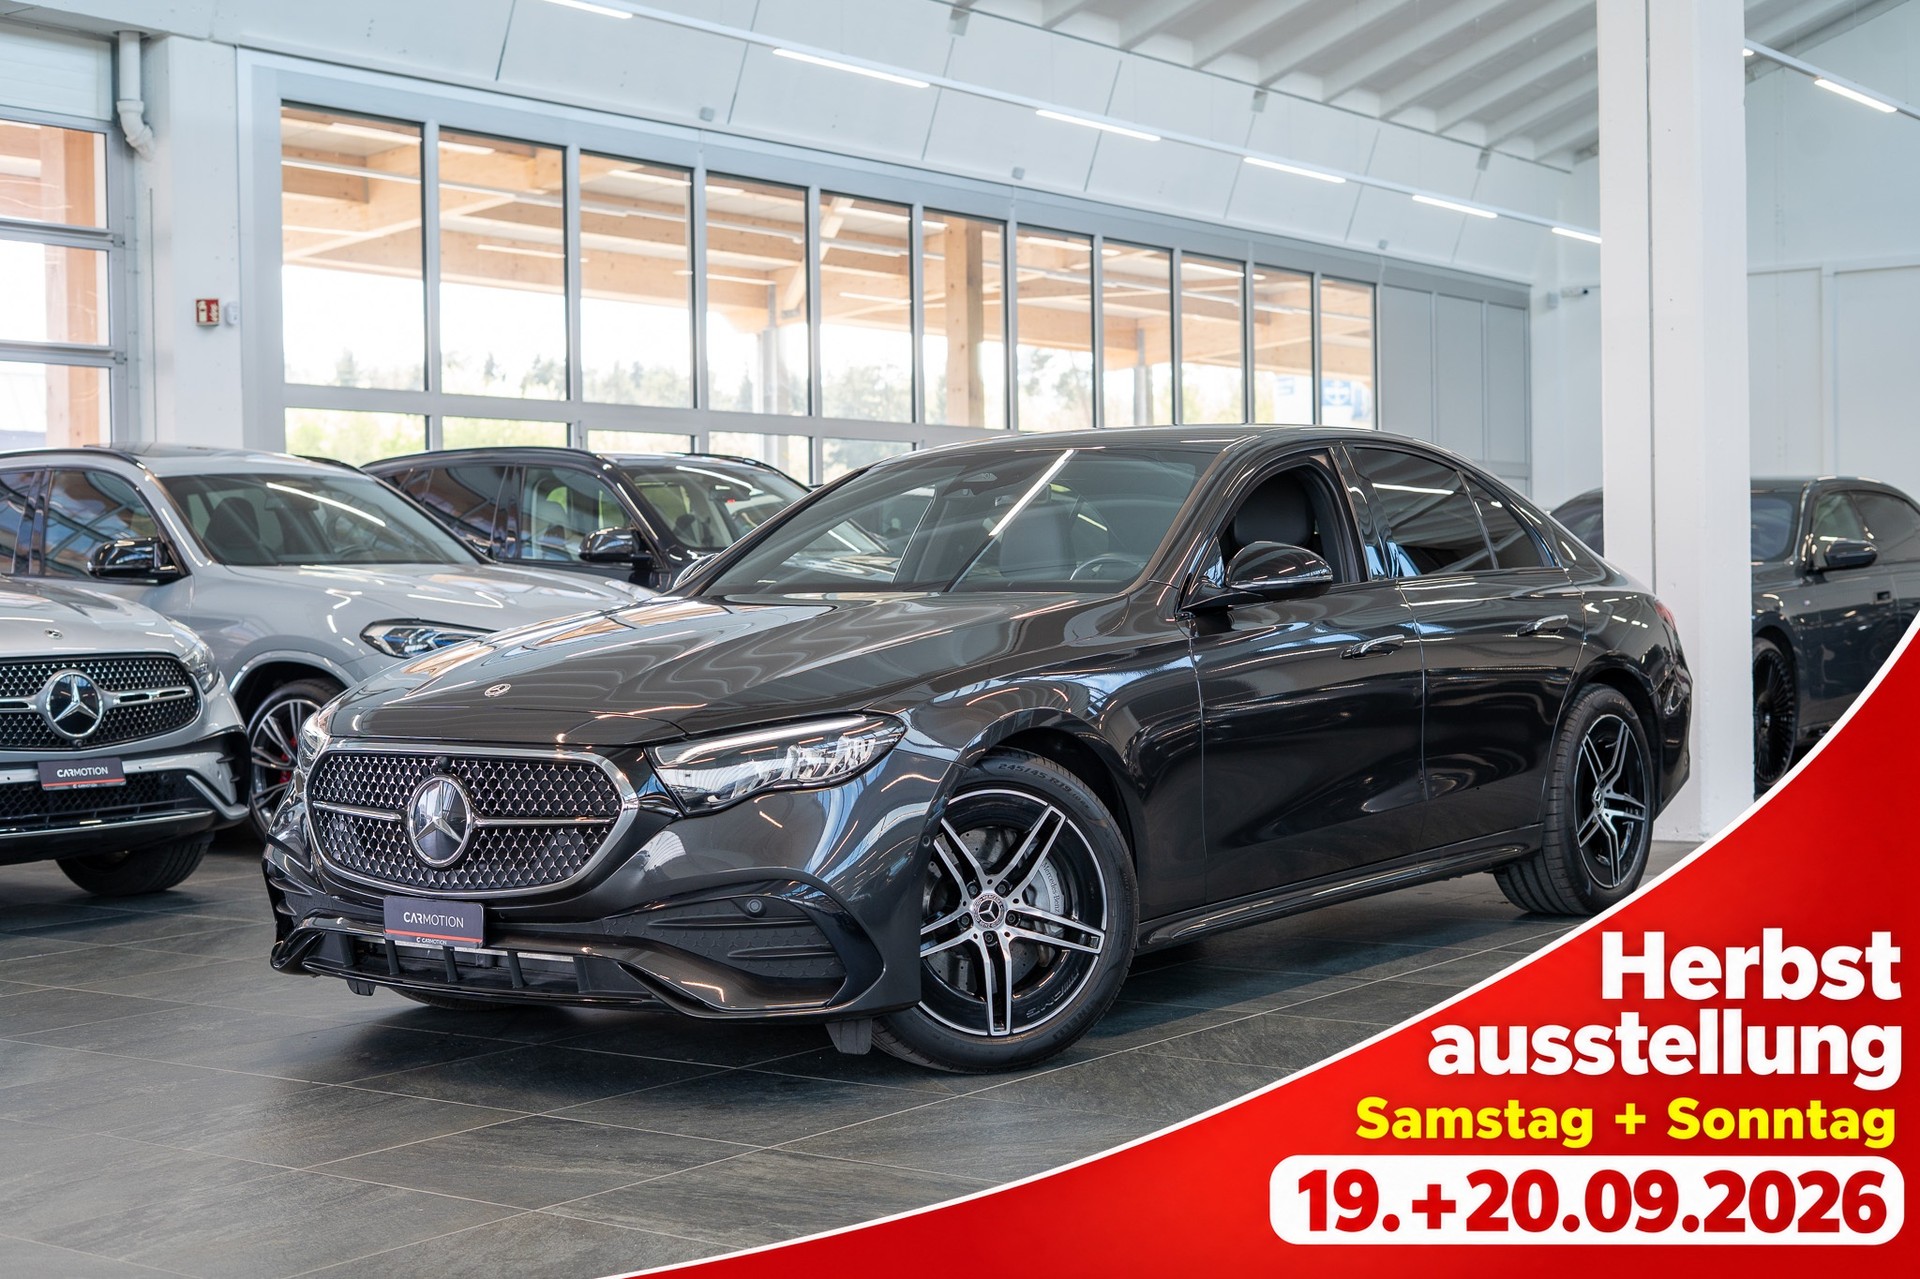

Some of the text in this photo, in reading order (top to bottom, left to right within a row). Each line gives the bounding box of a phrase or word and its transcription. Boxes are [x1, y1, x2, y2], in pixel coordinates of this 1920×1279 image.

[56, 766, 109, 778] CARMOTION
[998, 763, 1048, 779] 245/45
[403, 911, 464, 929] CARMOTION
